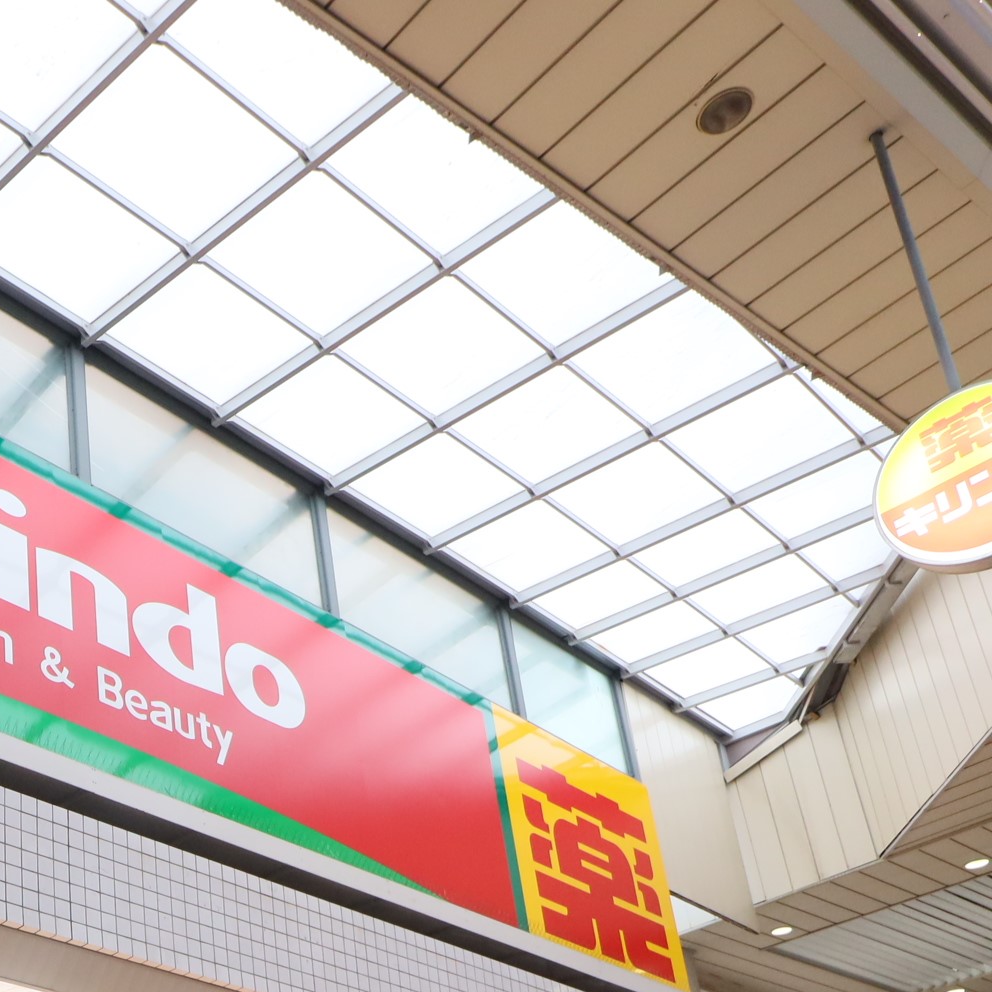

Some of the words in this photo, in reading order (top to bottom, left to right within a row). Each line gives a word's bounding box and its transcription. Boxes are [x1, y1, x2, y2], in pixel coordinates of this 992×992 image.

[40, 646, 75, 689] &
[97, 665, 233, 766] Beauty
[516, 757, 676, 983] 薬
